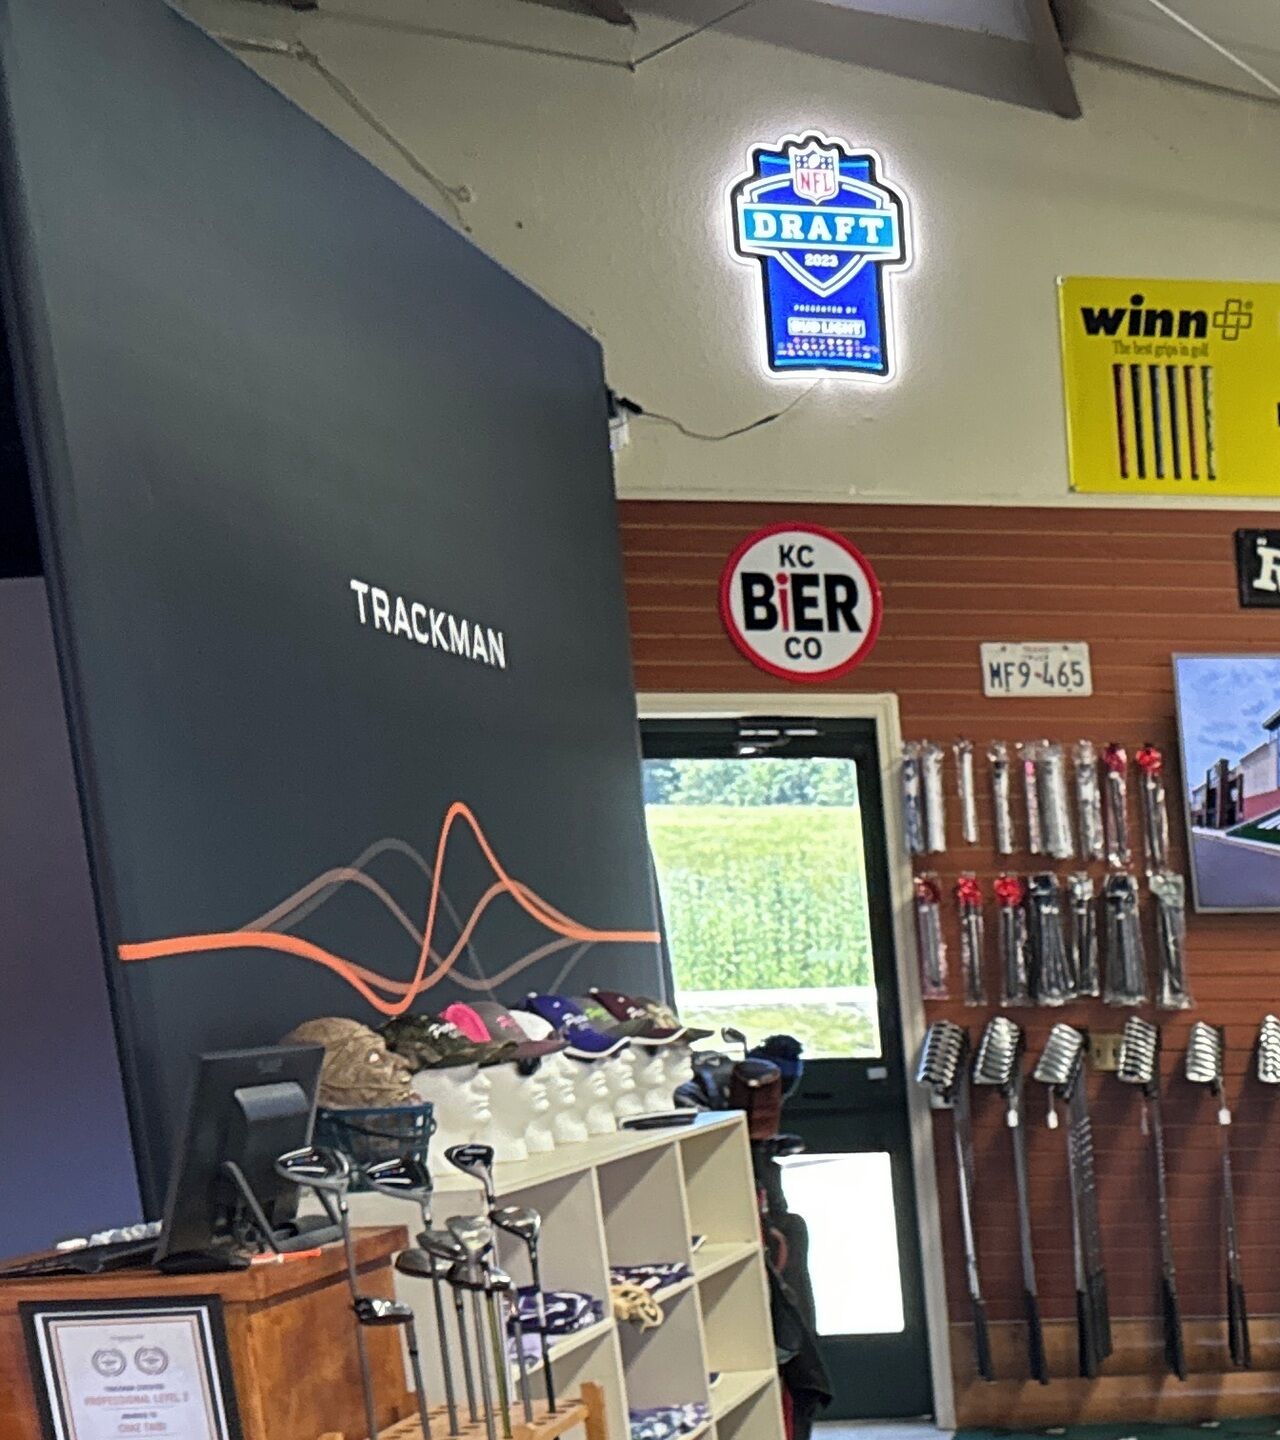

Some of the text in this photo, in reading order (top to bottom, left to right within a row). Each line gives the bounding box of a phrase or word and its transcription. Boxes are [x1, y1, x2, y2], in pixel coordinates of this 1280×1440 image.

[800, 172, 833, 192] NFL
[753, 212, 884, 244] DRAFT
[1081, 294, 1208, 339] winn
[778, 544, 814, 569] KC
[350, 578, 506, 670] TRACKMAN
[784, 637, 822, 660] CO
